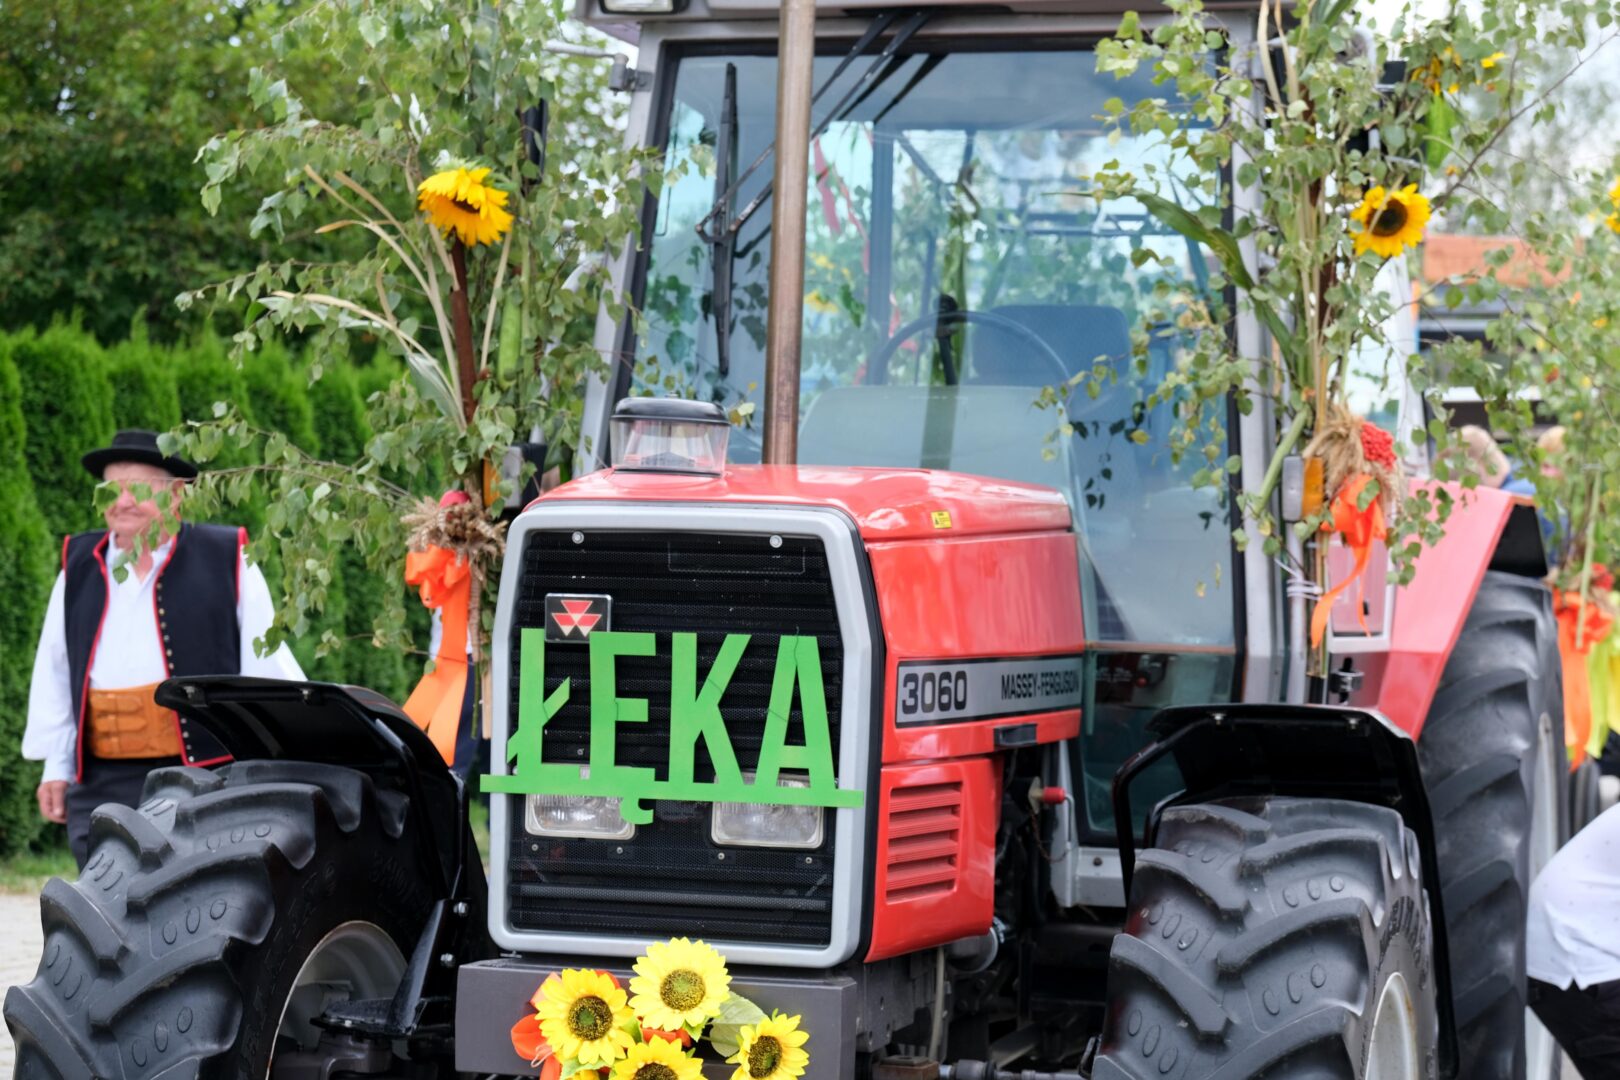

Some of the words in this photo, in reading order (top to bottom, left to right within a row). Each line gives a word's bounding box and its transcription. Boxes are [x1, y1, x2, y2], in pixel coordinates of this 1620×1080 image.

[507, 628, 836, 824] ŁĘKA
[902, 671, 967, 715] 3060
[1001, 670, 1080, 700] MASSEY-FERGUSON
